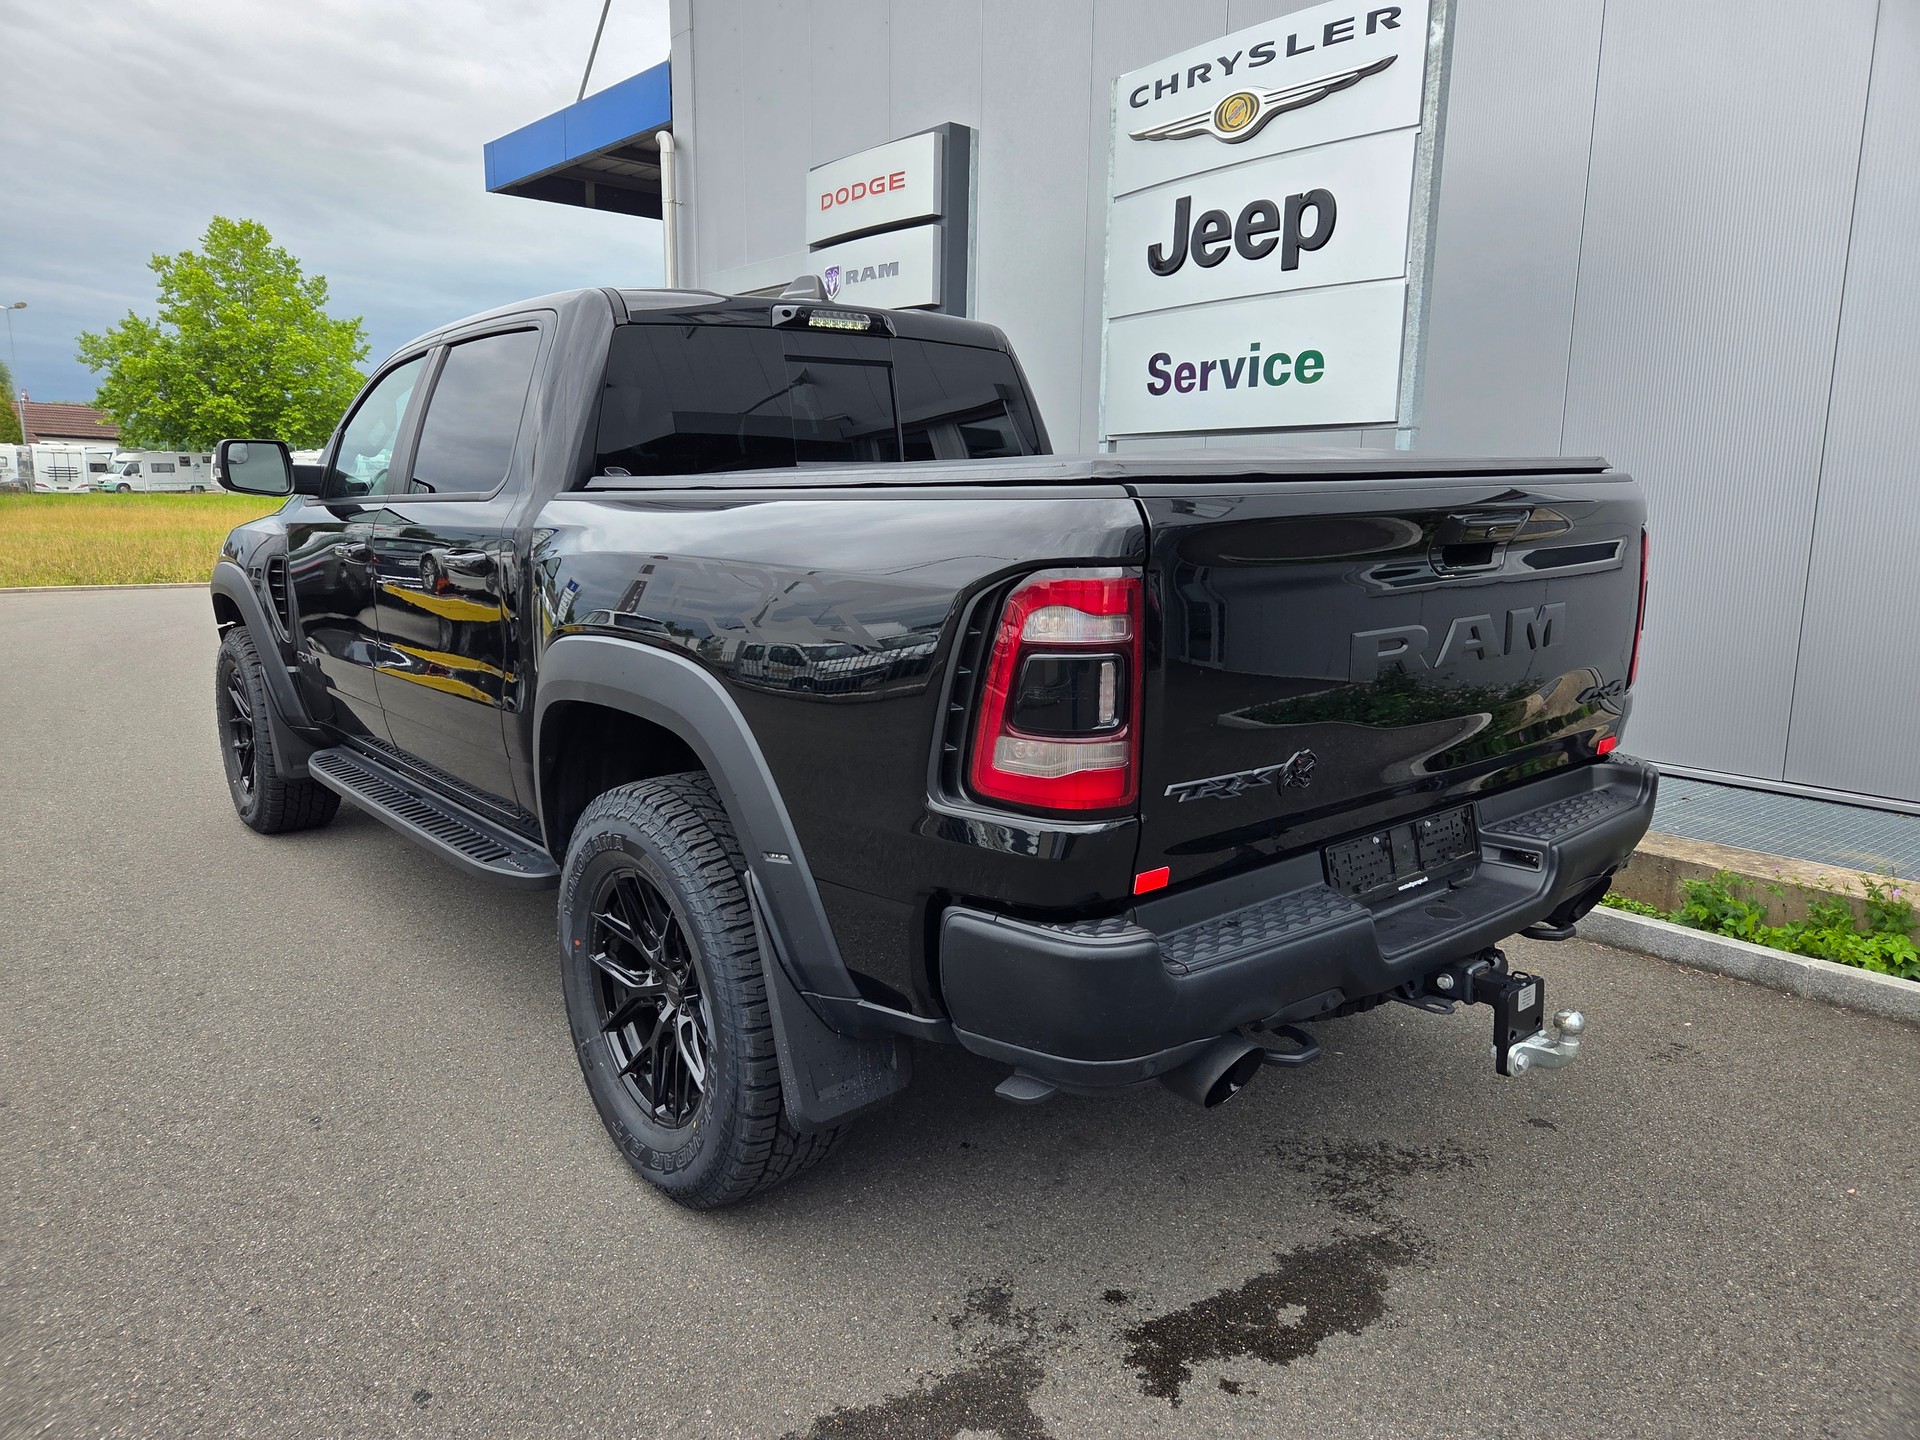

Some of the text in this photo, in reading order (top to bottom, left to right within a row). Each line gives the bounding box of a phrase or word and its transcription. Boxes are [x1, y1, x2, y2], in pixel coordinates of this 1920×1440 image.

[1129, 5, 1402, 108] CHRYSLER
[821, 170, 906, 211] DODGE
[1147, 187, 1338, 277] Jeep
[845, 261, 899, 285] RAM
[1146, 342, 1325, 396] Service
[1349, 601, 1567, 684] RAM
[1163, 763, 1286, 803] TRX
[563, 833, 625, 916] YOKOHAMA
